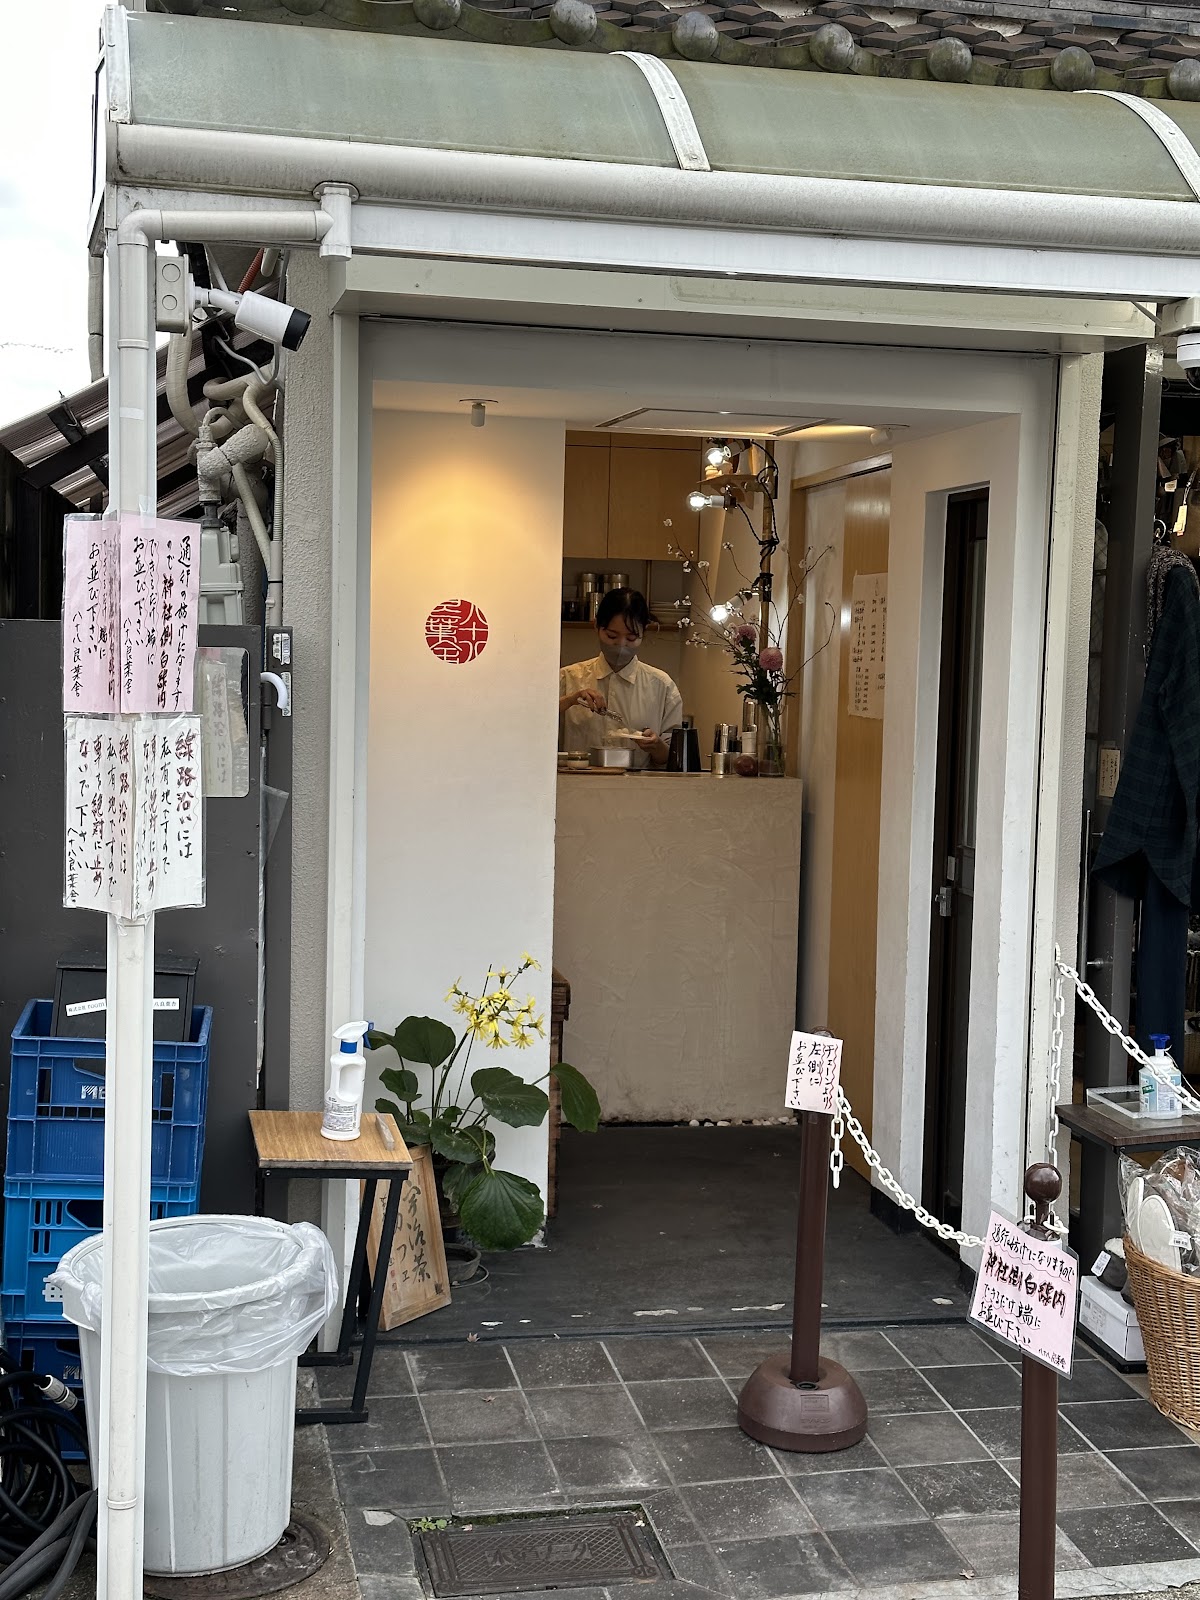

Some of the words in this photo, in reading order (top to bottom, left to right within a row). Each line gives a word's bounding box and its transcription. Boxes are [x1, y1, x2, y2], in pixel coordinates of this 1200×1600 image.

[87, 543, 100, 653] お並び下さい
[133, 536, 146, 646] お並び下さい
[75, 739, 90, 869] ないで下さい
[119, 734, 130, 874] 線路沿いには
[175, 728, 197, 858] 線路沿いには
[790, 1040, 807, 1105] お並び下さい
[807, 1041, 822, 1086] 左側に
[978, 1301, 1032, 1344] お並び下さい
[984, 1282, 1042, 1328] できるだけ端に
[985, 1246, 1066, 1318] 神社側白線内
